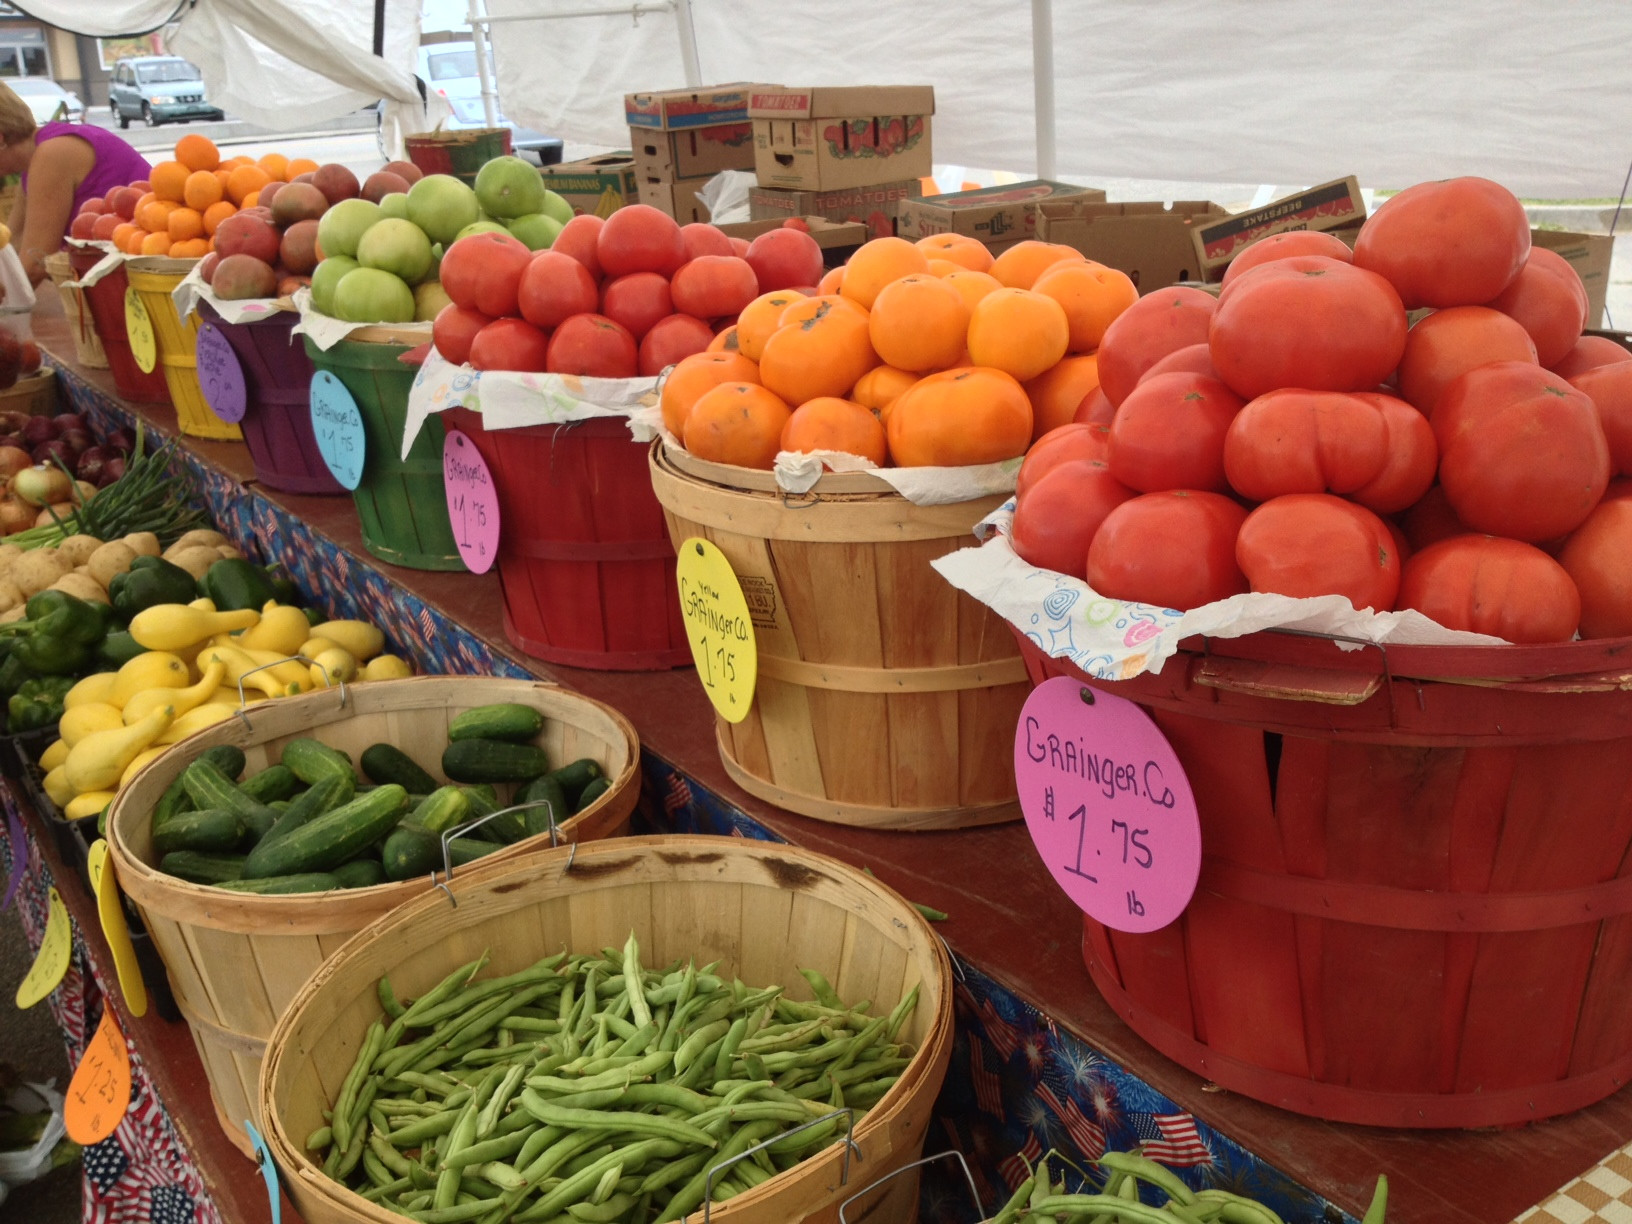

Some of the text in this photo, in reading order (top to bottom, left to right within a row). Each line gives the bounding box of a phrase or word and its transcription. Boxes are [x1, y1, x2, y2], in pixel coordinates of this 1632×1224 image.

[757, 95, 803, 110] TOMATOES
[752, 195, 795, 209] TOMATOES
[815, 188, 909, 210] TOMATOES
[1243, 200, 1303, 228] BEEFSTAKE
[700, 636, 735, 688] 1.75
[1126, 890, 1145, 916] lb
